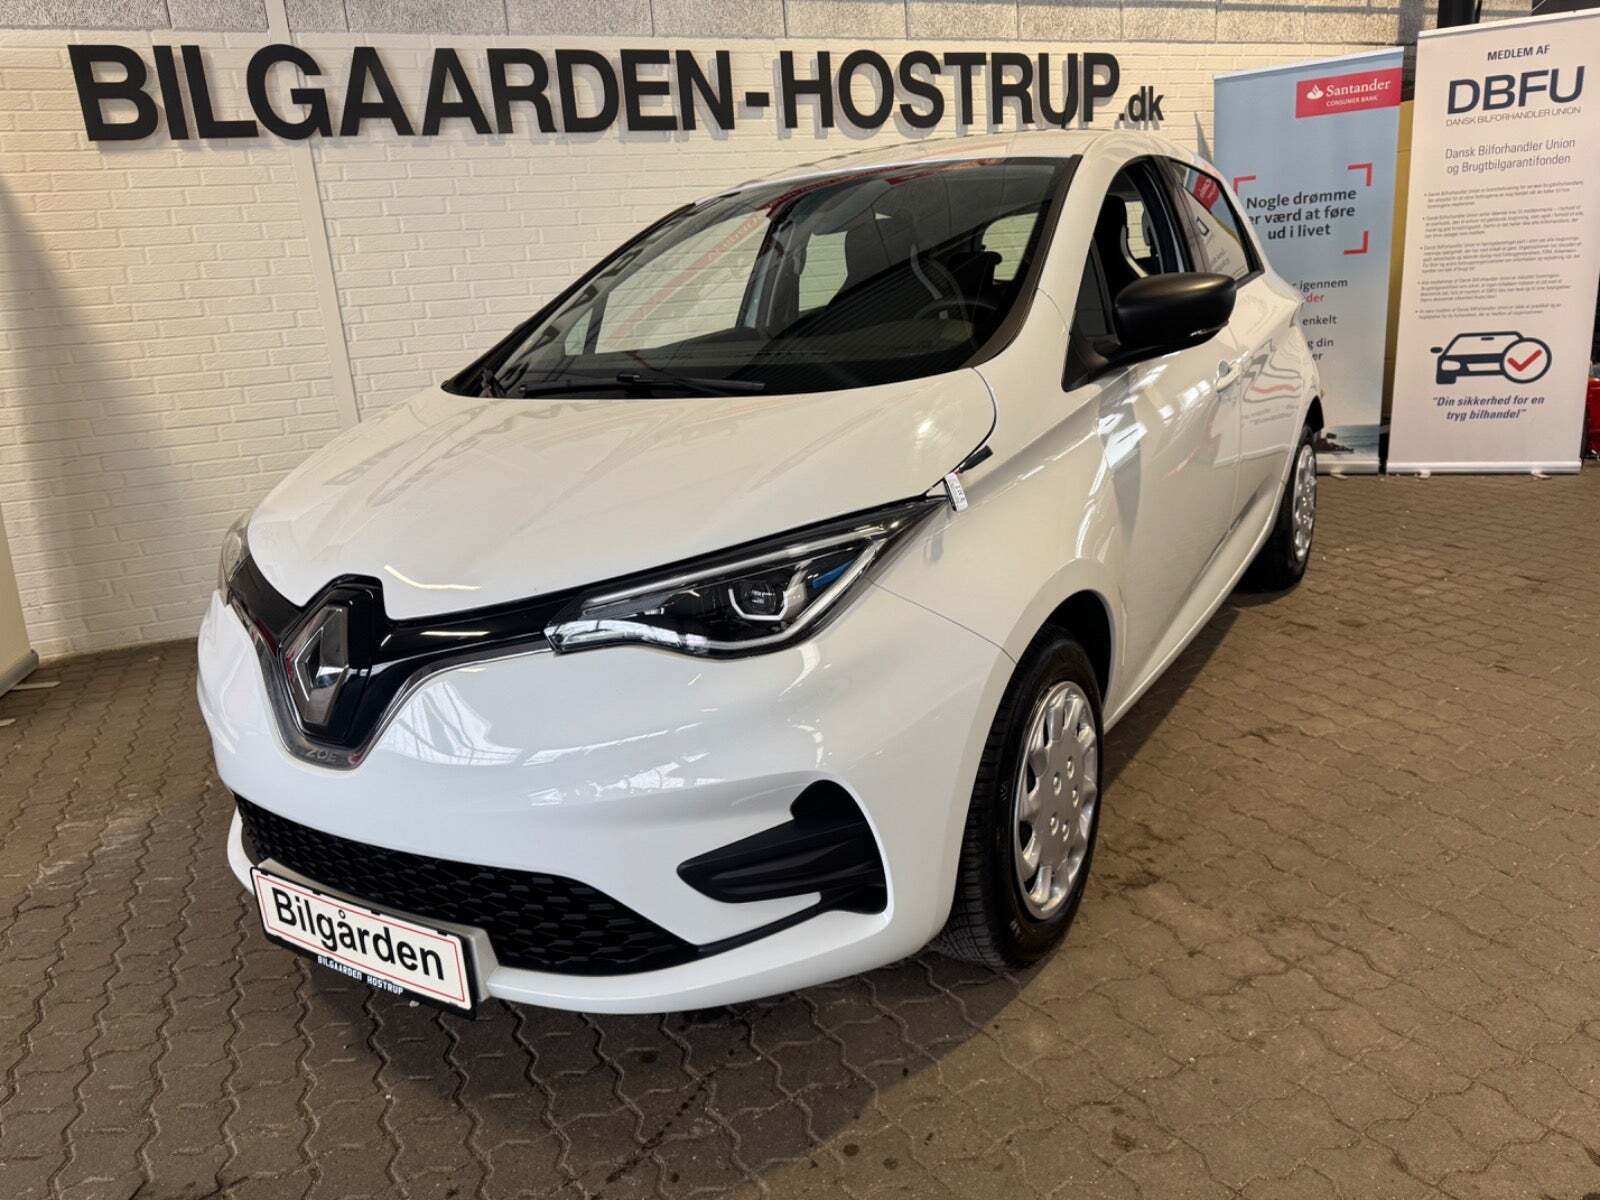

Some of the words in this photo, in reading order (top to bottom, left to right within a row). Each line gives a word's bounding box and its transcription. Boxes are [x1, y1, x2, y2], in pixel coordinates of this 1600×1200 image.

[1487, 46, 1533, 61] MEDLEM
[1536, 44, 1550, 55] AF
[1325, 78, 1392, 98] Santander
[1447, 65, 1585, 115] DBFU
[1326, 97, 1360, 107] CONSUMER
[1446, 117, 1476, 127] DANSK
[1477, 108, 1551, 124] BILFORHANDLER
[1551, 106, 1581, 117] UNION
[1445, 146, 1475, 159] Dansk
[1478, 140, 1542, 156] Bilforhandler
[1545, 137, 1576, 150] Union
[1446, 164, 1459, 176] og
[1462, 154, 1571, 174] Brugtbilgarantifonden
[1246, 193, 1290, 211] Nogle
[1293, 189, 1357, 205] drømme
[1264, 208, 1301, 224] værd
[1305, 208, 1321, 221] at
[1324, 205, 1356, 219] føre
[1267, 225, 1286, 240] ud
[1290, 225, 1294, 239] i
[1297, 223, 1331, 237] livet
[1300, 279, 1348, 292] igennem
[1302, 314, 1337, 326] enkelt
[1316, 337, 1334, 348] din
[1457, 395, 1511, 406] sikkerhed
[1513, 394, 1528, 405] for
[1531, 395, 1545, 405] en
[1446, 411, 1467, 422] tryg
[271, 886, 445, 981] Bilgården
[317, 955, 363, 981] BILGAARDEN
[366, 975, 404, 995] HOSTRUP
